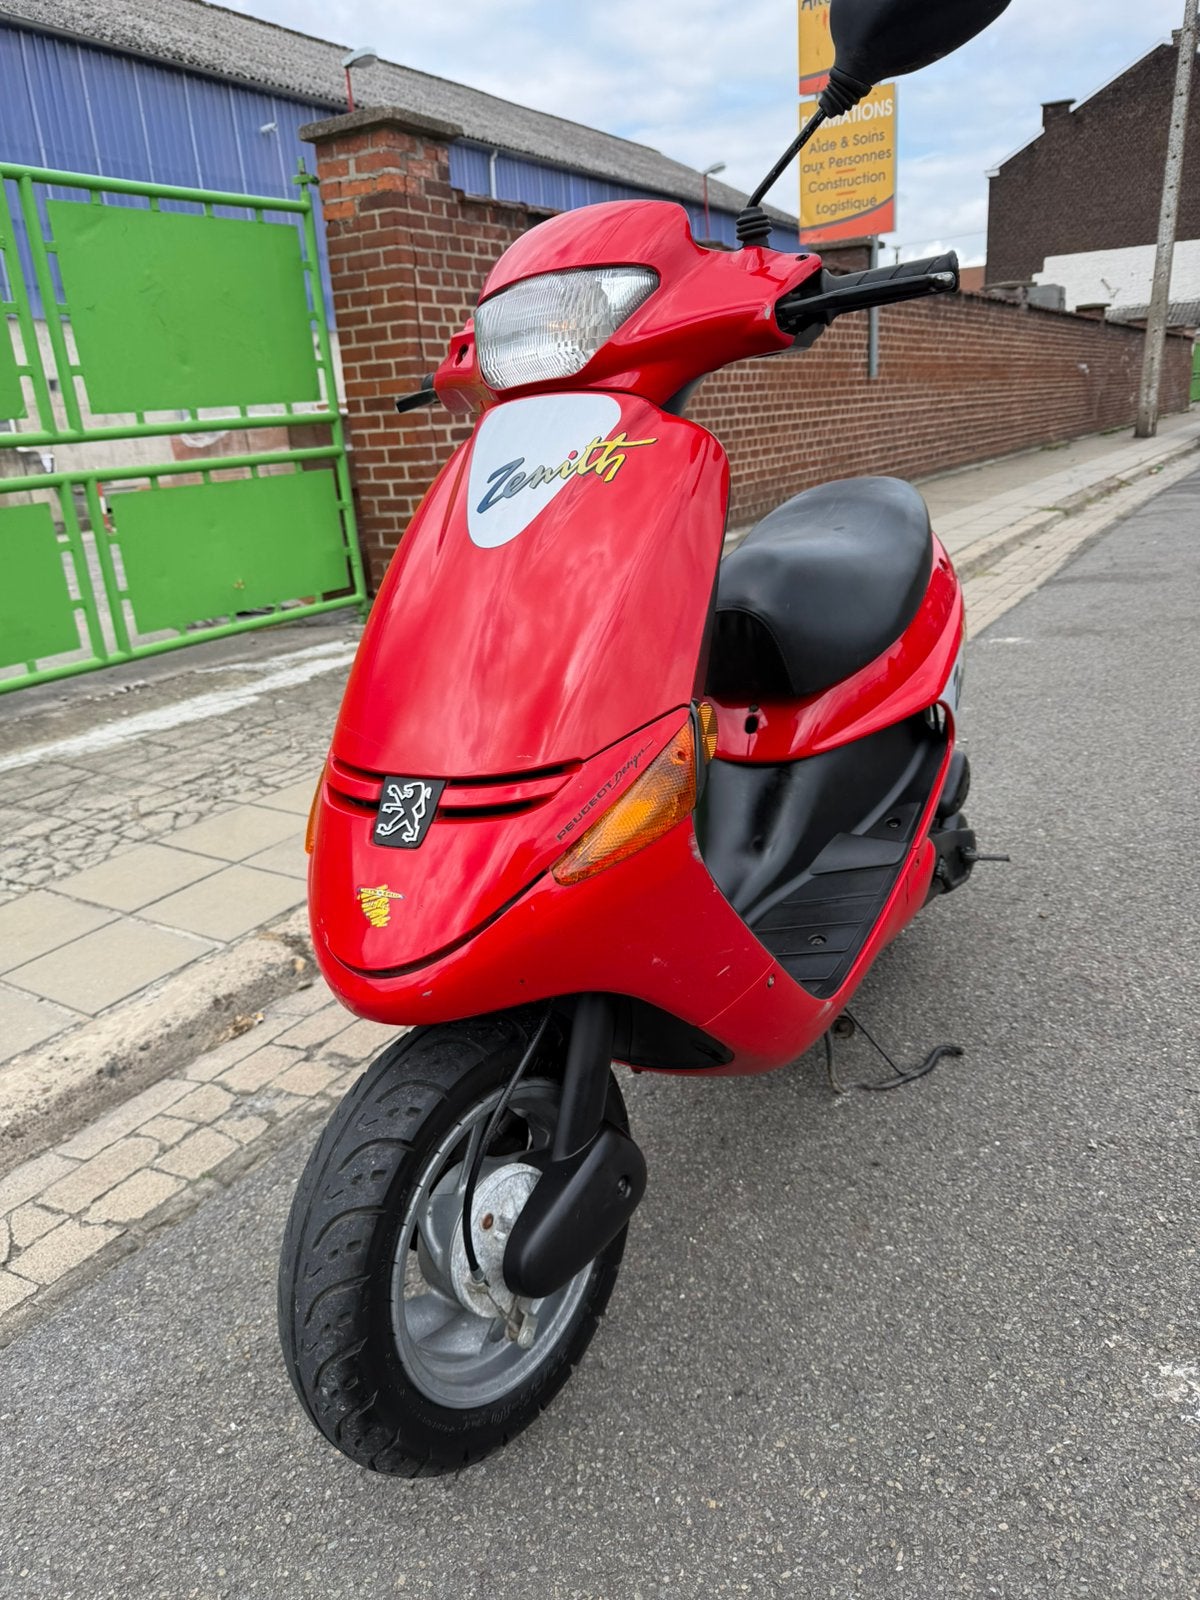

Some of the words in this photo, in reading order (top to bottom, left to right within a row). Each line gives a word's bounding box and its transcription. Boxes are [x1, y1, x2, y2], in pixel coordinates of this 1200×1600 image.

[809, 140, 837, 154] Aide
[840, 136, 849, 148] &
[853, 131, 885, 146] Soins
[802, 161, 825, 174] aux
[828, 148, 892, 168] Personnes
[808, 171, 886, 193] Construction
[816, 196, 877, 216] Logistique
[476, 432, 658, 514] Zenith
[556, 781, 613, 841] PEUGEOT
[611, 739, 654, 791] Design
